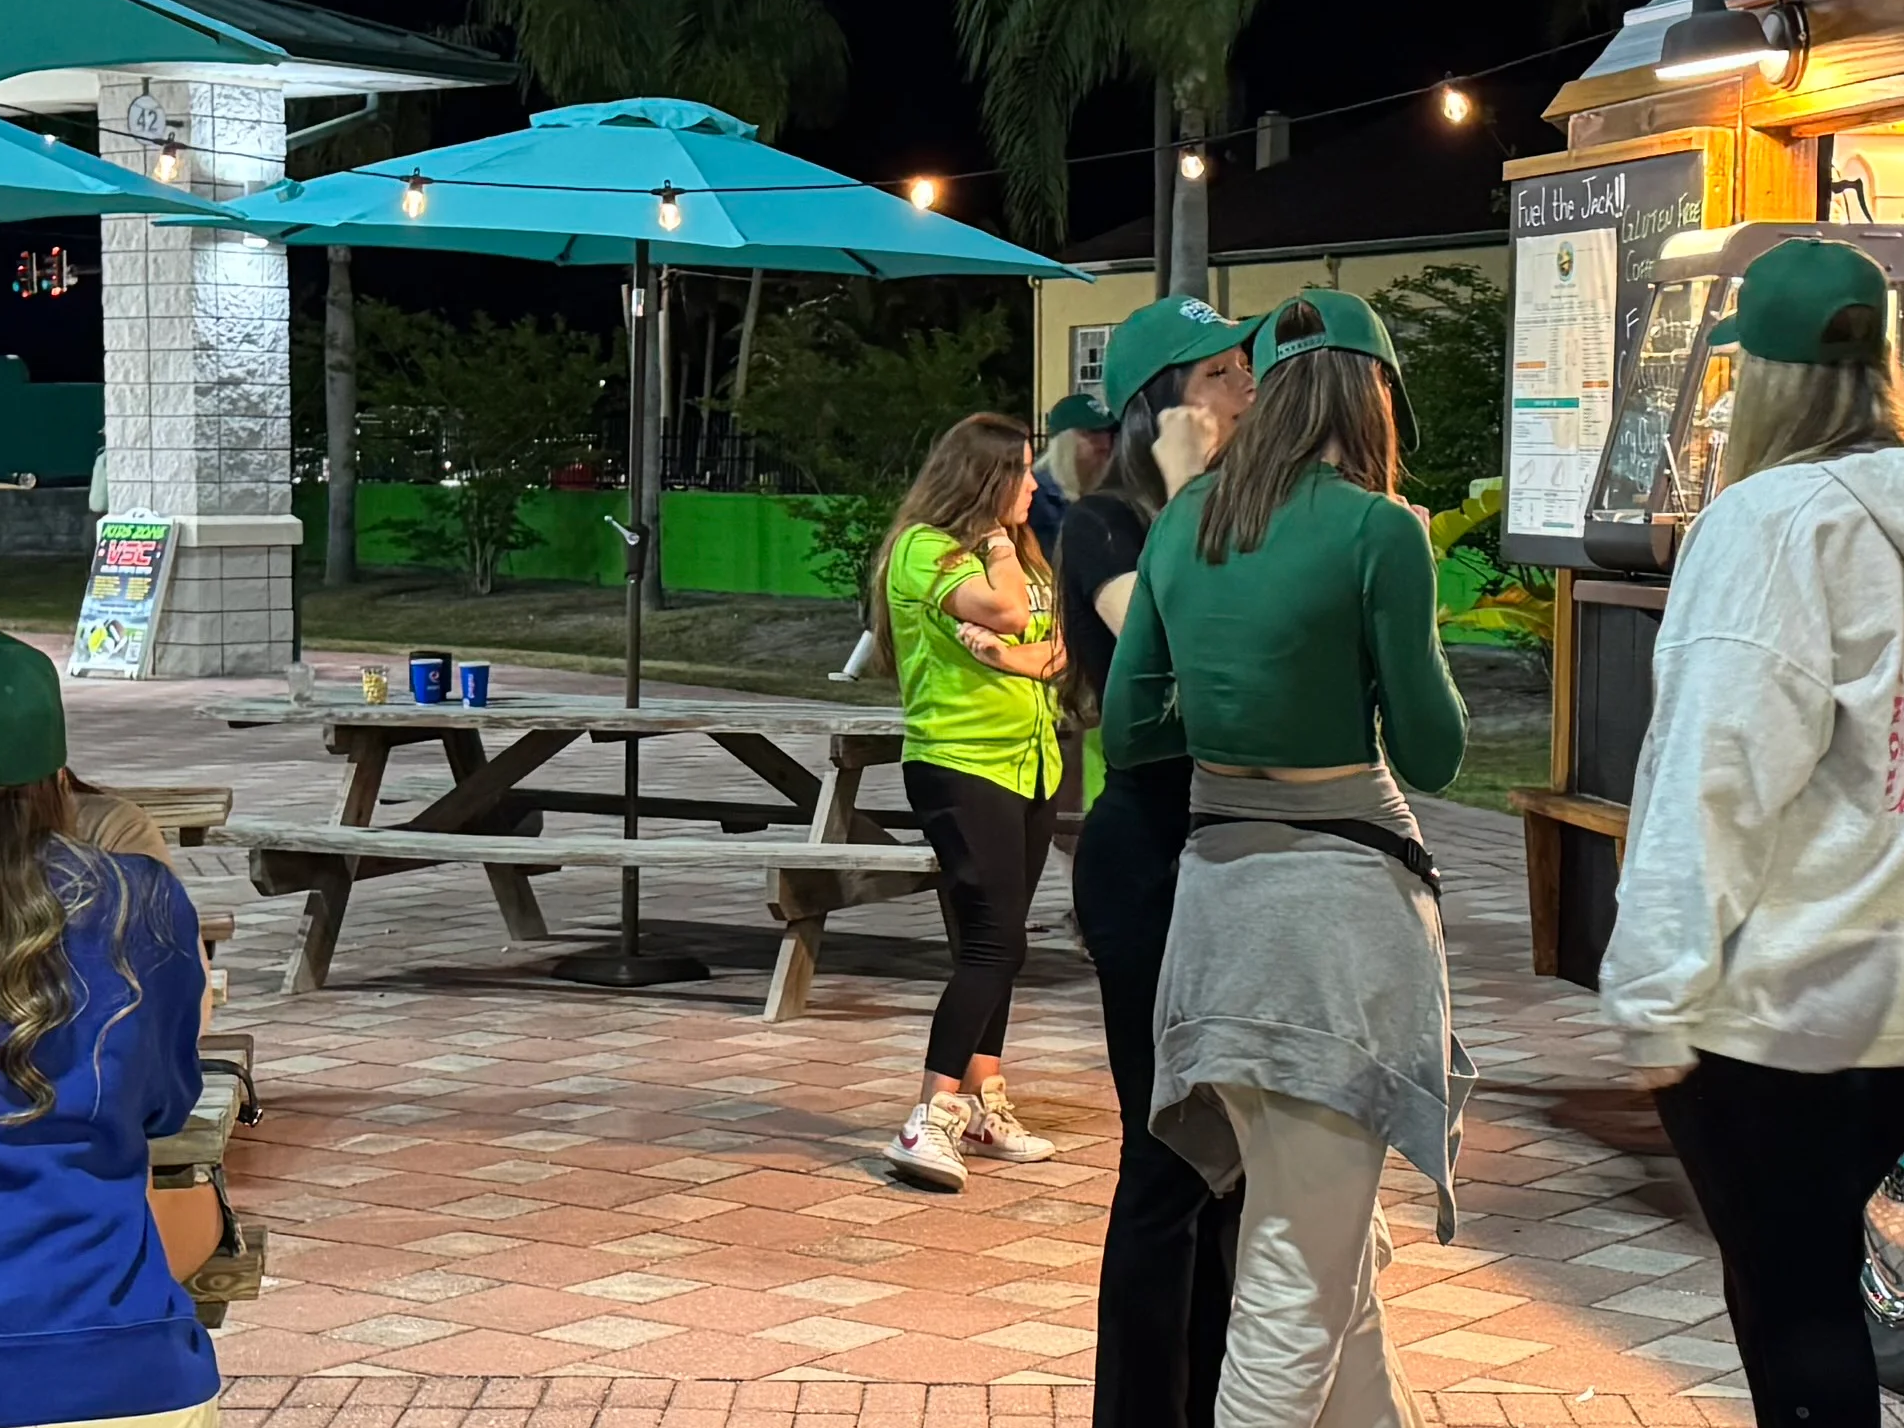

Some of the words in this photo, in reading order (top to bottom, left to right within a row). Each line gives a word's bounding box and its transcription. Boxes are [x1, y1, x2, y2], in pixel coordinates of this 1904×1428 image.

[137, 108, 158, 132] 42
[1517, 185, 1546, 229] Fuel
[1551, 186, 1575, 222] the
